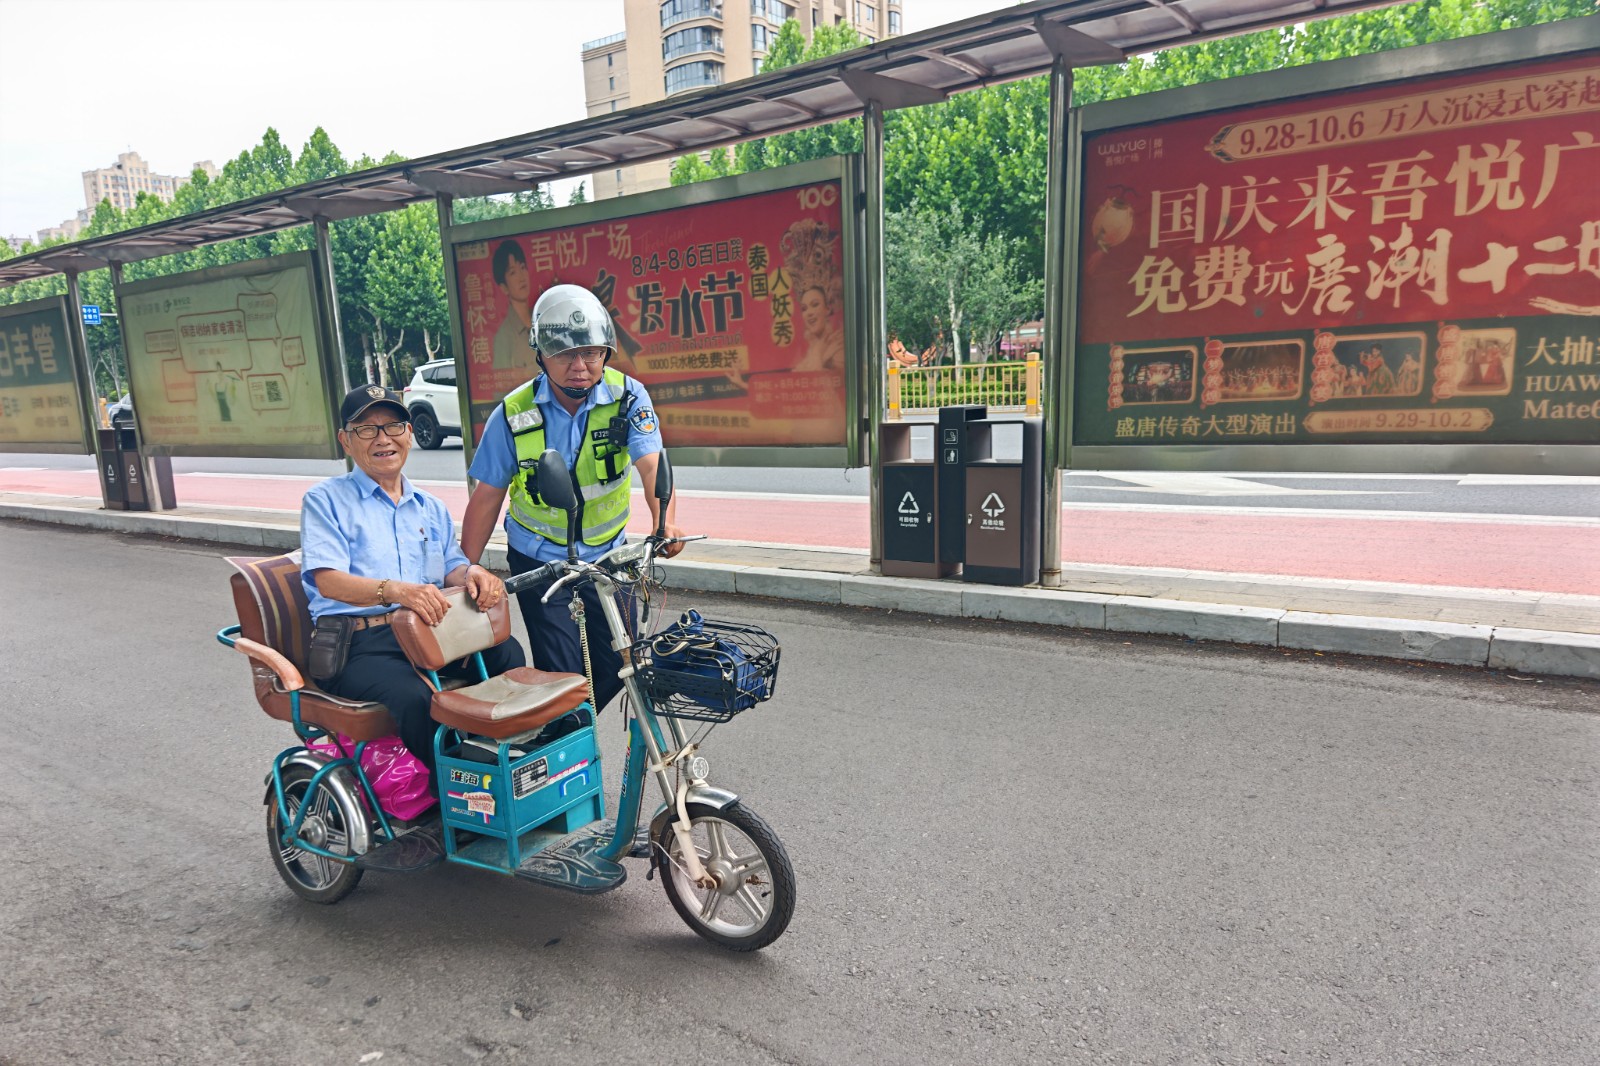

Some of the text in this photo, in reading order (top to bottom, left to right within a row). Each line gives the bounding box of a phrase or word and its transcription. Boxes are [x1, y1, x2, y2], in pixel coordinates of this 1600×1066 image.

[1240, 112, 1364, 155] 9.28-10.6
[1105, 155, 1140, 167] 吾悦广场
[796, 184, 837, 210] 100
[530, 223, 632, 272] 吾悦广场
[748, 245, 793, 346] 泰国 人妖秀
[463, 273, 492, 365] 鲁怀德
[1525, 335, 1600, 367] 大抽
[1115, 412, 1296, 438] 盛唐传奇大型演出
[1321, 411, 1472, 430] 演出时间 9.29-10.2
[899, 516, 919, 524] 可回收物
